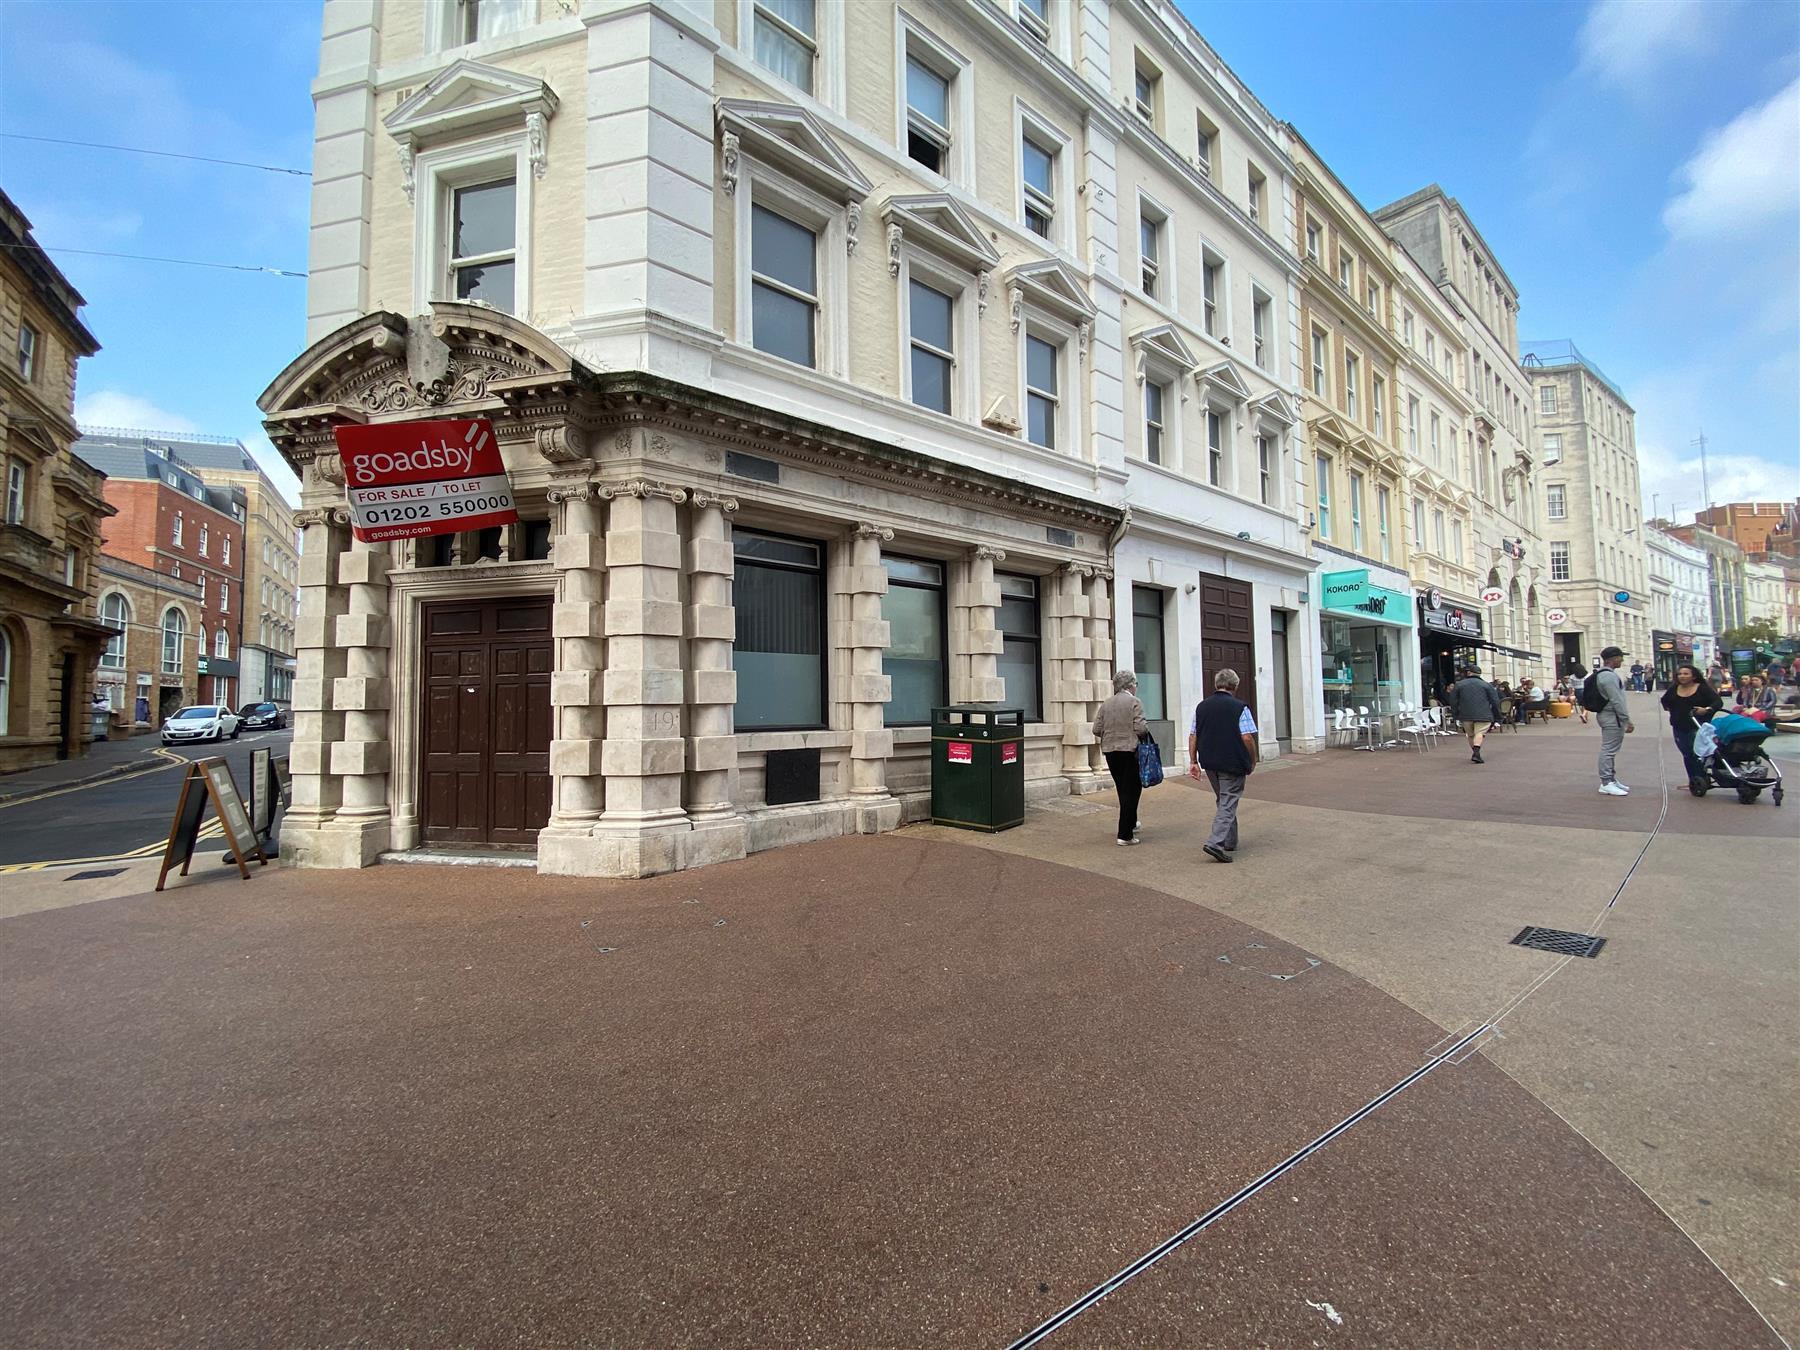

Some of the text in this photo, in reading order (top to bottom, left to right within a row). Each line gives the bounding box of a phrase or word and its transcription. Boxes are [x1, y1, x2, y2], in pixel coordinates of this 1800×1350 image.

[353, 440, 473, 483] goadsby
[358, 491, 387, 502] FOR
[391, 487, 426, 500] SALE
[442, 484, 459, 494] TO
[463, 481, 482, 492] LET
[366, 495, 509, 524] 01202 550000
[371, 525, 432, 540] goadsby.com
[1326, 583, 1360, 594] KOKORO
[654, 711, 674, 731] 19
